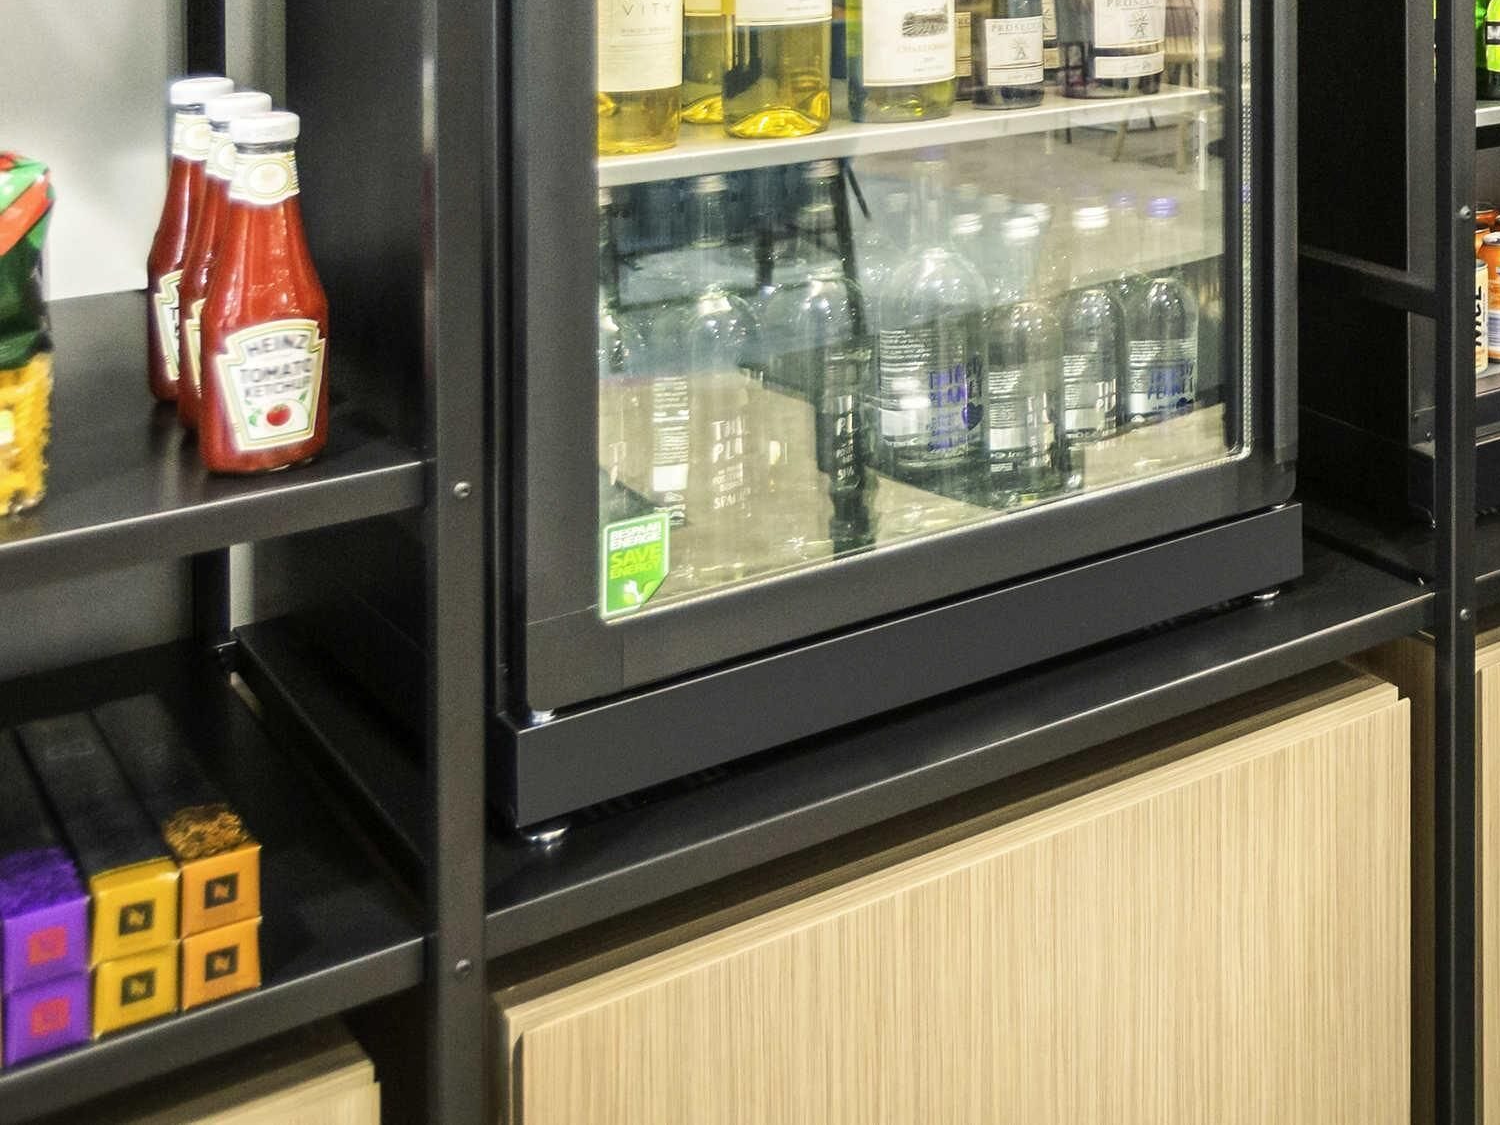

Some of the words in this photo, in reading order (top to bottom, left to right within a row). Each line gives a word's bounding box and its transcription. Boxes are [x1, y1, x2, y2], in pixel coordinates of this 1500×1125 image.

[246, 334, 309, 356] HEINZ
[239, 358, 312, 385] TOMATO
[244, 375, 311, 398] KETCHUP
[611, 543, 661, 567] SAVE
